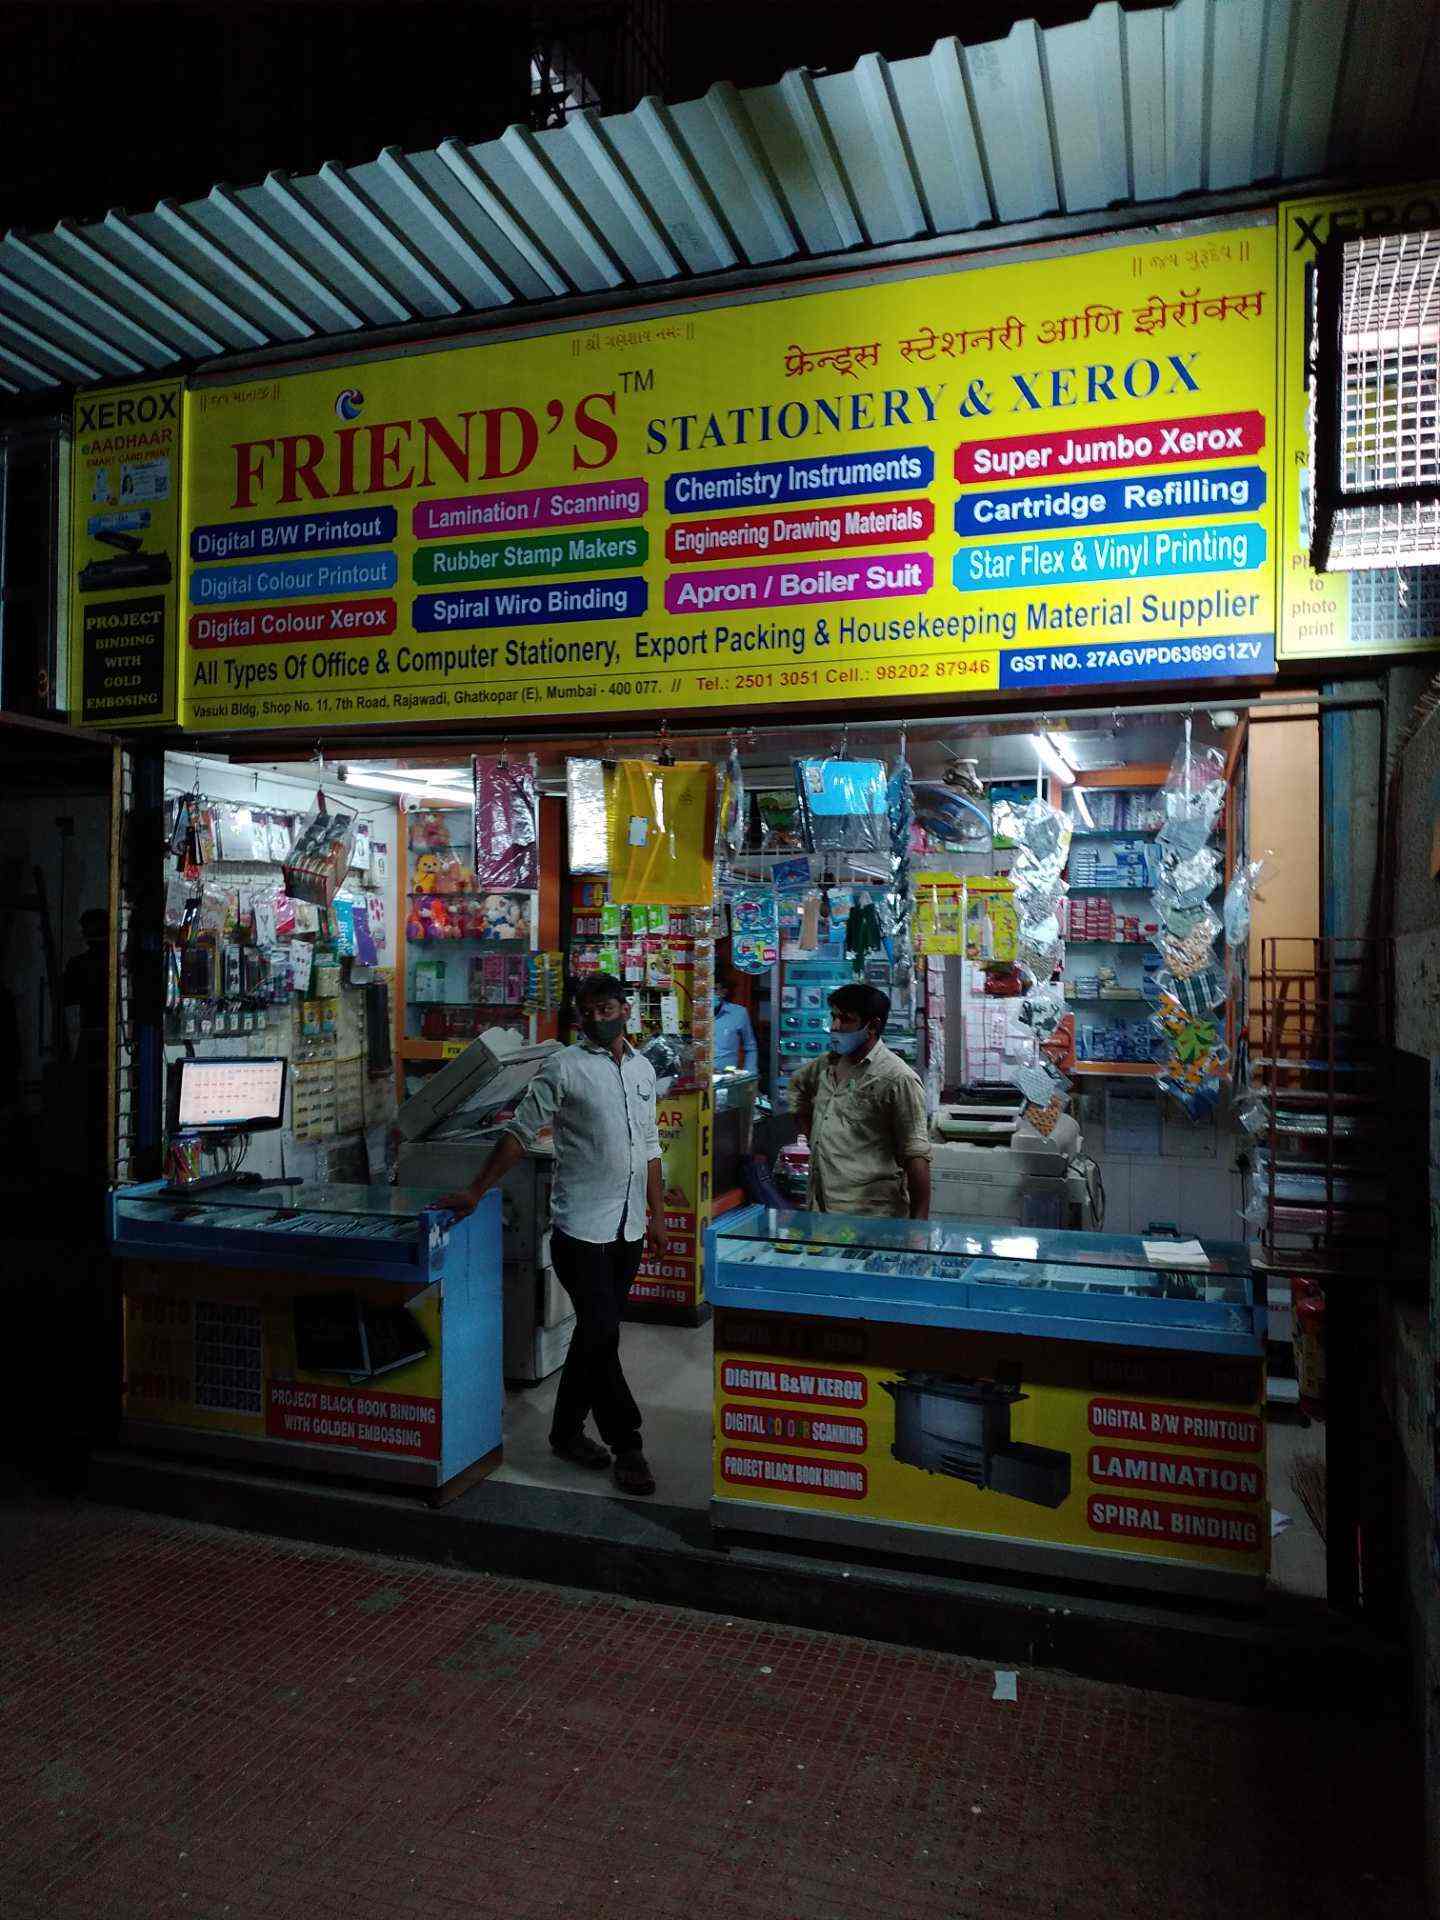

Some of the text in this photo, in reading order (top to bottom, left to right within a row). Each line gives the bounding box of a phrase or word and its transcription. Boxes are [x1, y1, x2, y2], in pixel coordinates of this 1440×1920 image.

[899, 316, 1025, 363] स्टेशनरी
[1037, 304, 1123, 344] आणि
[1132, 289, 1266, 335] झेरॉक्स
[618, 369, 653, 393] TM
[79, 393, 177, 433] XEROX
[647, 353, 1200, 456] STATIONERY & XEROX
[230, 391, 618, 509] FRIEND'S
[973, 427, 1244, 476] Super Jumbo Xerox
[674, 454, 922, 503] Chemistry Instruments
[429, 490, 641, 529] Lamination / Scanning
[973, 479, 1249, 524] Cartridge Refilling
[198, 515, 383, 556] Digital B/W Printout
[674, 506, 923, 554] Engineering Drawing Materials
[433, 538, 638, 574] Rubber Stamp Makers
[970, 529, 1248, 581] Star Flex & Vinyl Printing
[200, 561, 388, 599] Digital Colour Printout
[677, 563, 922, 609] Apron / Boiler Suit
[1309, 577, 1324, 591] to
[87, 610, 162, 631] PROJECT
[198, 606, 386, 642] Digital Colour Xerox
[433, 588, 628, 625] Spiral Wiro Binding
[1292, 599, 1336, 618] photo
[194, 588, 1259, 690] All Types Of Office & Computer Stationery, Export Packing & Housekeeping Material Supplier
[1298, 621, 1335, 640] print
[104, 655, 142, 669] WITH
[1010, 642, 1262, 673] GST NO. 27AGVPD6369G1ZV
[193, 702, 228, 718] Vasuki
[263, 699, 291, 715] Shop
[294, 700, 313, 712] No.
[336, 697, 352, 710] 7th
[454, 688, 517, 707] Ghatkopar
[547, 684, 596, 700] Mumbai
[609, 682, 630, 696] 400
[736, 674, 772, 689] 2501
[780, 671, 819, 686] 3051
[876, 663, 929, 680] 98202
[936, 659, 990, 677] 87946
[724, 1366, 779, 1391] DIGITAL
[817, 1378, 864, 1401] XEROX
[271, 1387, 437, 1425] PROJECT BLACK BOOK BINDING
[1092, 1406, 1257, 1443] DIGITAL B/W PRINTOUT
[313, 1417, 357, 1439] GOLDEN
[725, 1411, 765, 1434] DIGITAL
[811, 1421, 864, 1446] SCANNING
[725, 1455, 763, 1478] PROJECT
[764, 1461, 794, 1483] BLACK
[1092, 1454, 1257, 1494] LAMINATION
[1092, 1502, 1257, 1543] SPIRAL BINDING
